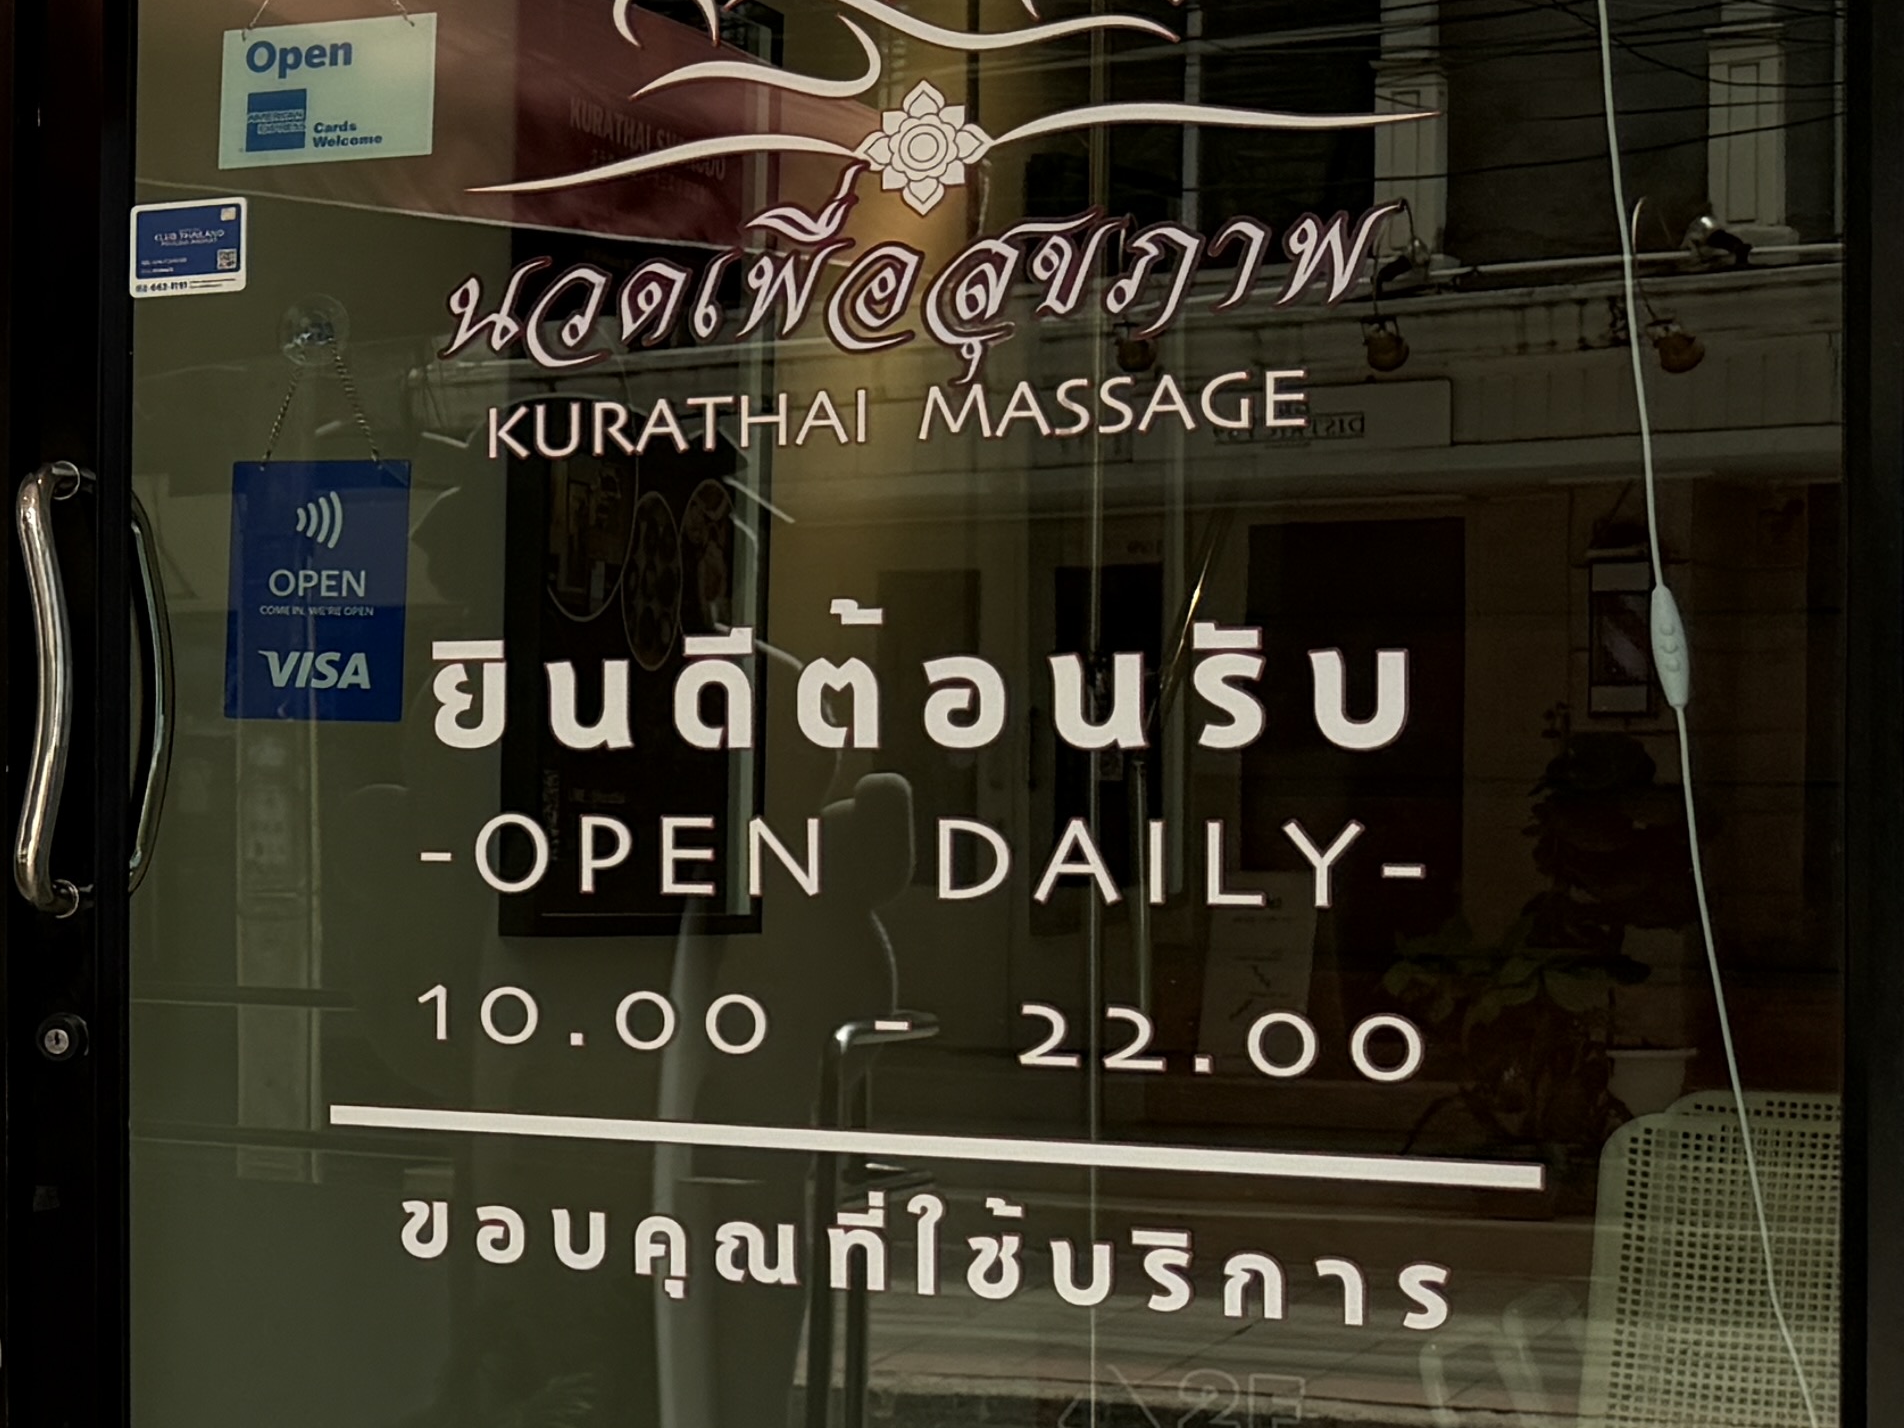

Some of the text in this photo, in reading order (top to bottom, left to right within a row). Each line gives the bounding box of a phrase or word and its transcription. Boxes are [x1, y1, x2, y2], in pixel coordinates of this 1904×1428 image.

[246, 40, 352, 79] Open
[313, 121, 357, 134] Cards
[313, 135, 382, 148] Welcome
[441, 161, 1404, 382] นวดเพื่อสุขภาพ
[486, 389, 868, 461] KURATHAI
[919, 370, 1307, 445] MASSAGE
[269, 569, 365, 598] OPEN
[259, 605, 289, 616] COME
[344, 606, 374, 617] OPEN
[258, 649, 371, 689] VISA
[431, 598, 1414, 753] ยินดีต้อนรับ
[417, 982, 772, 1055] 10.00
[1018, 1004, 1426, 1082] 22.00
[401, 1191, 1450, 1331] ขอบคุณที่ใช้บริการ
